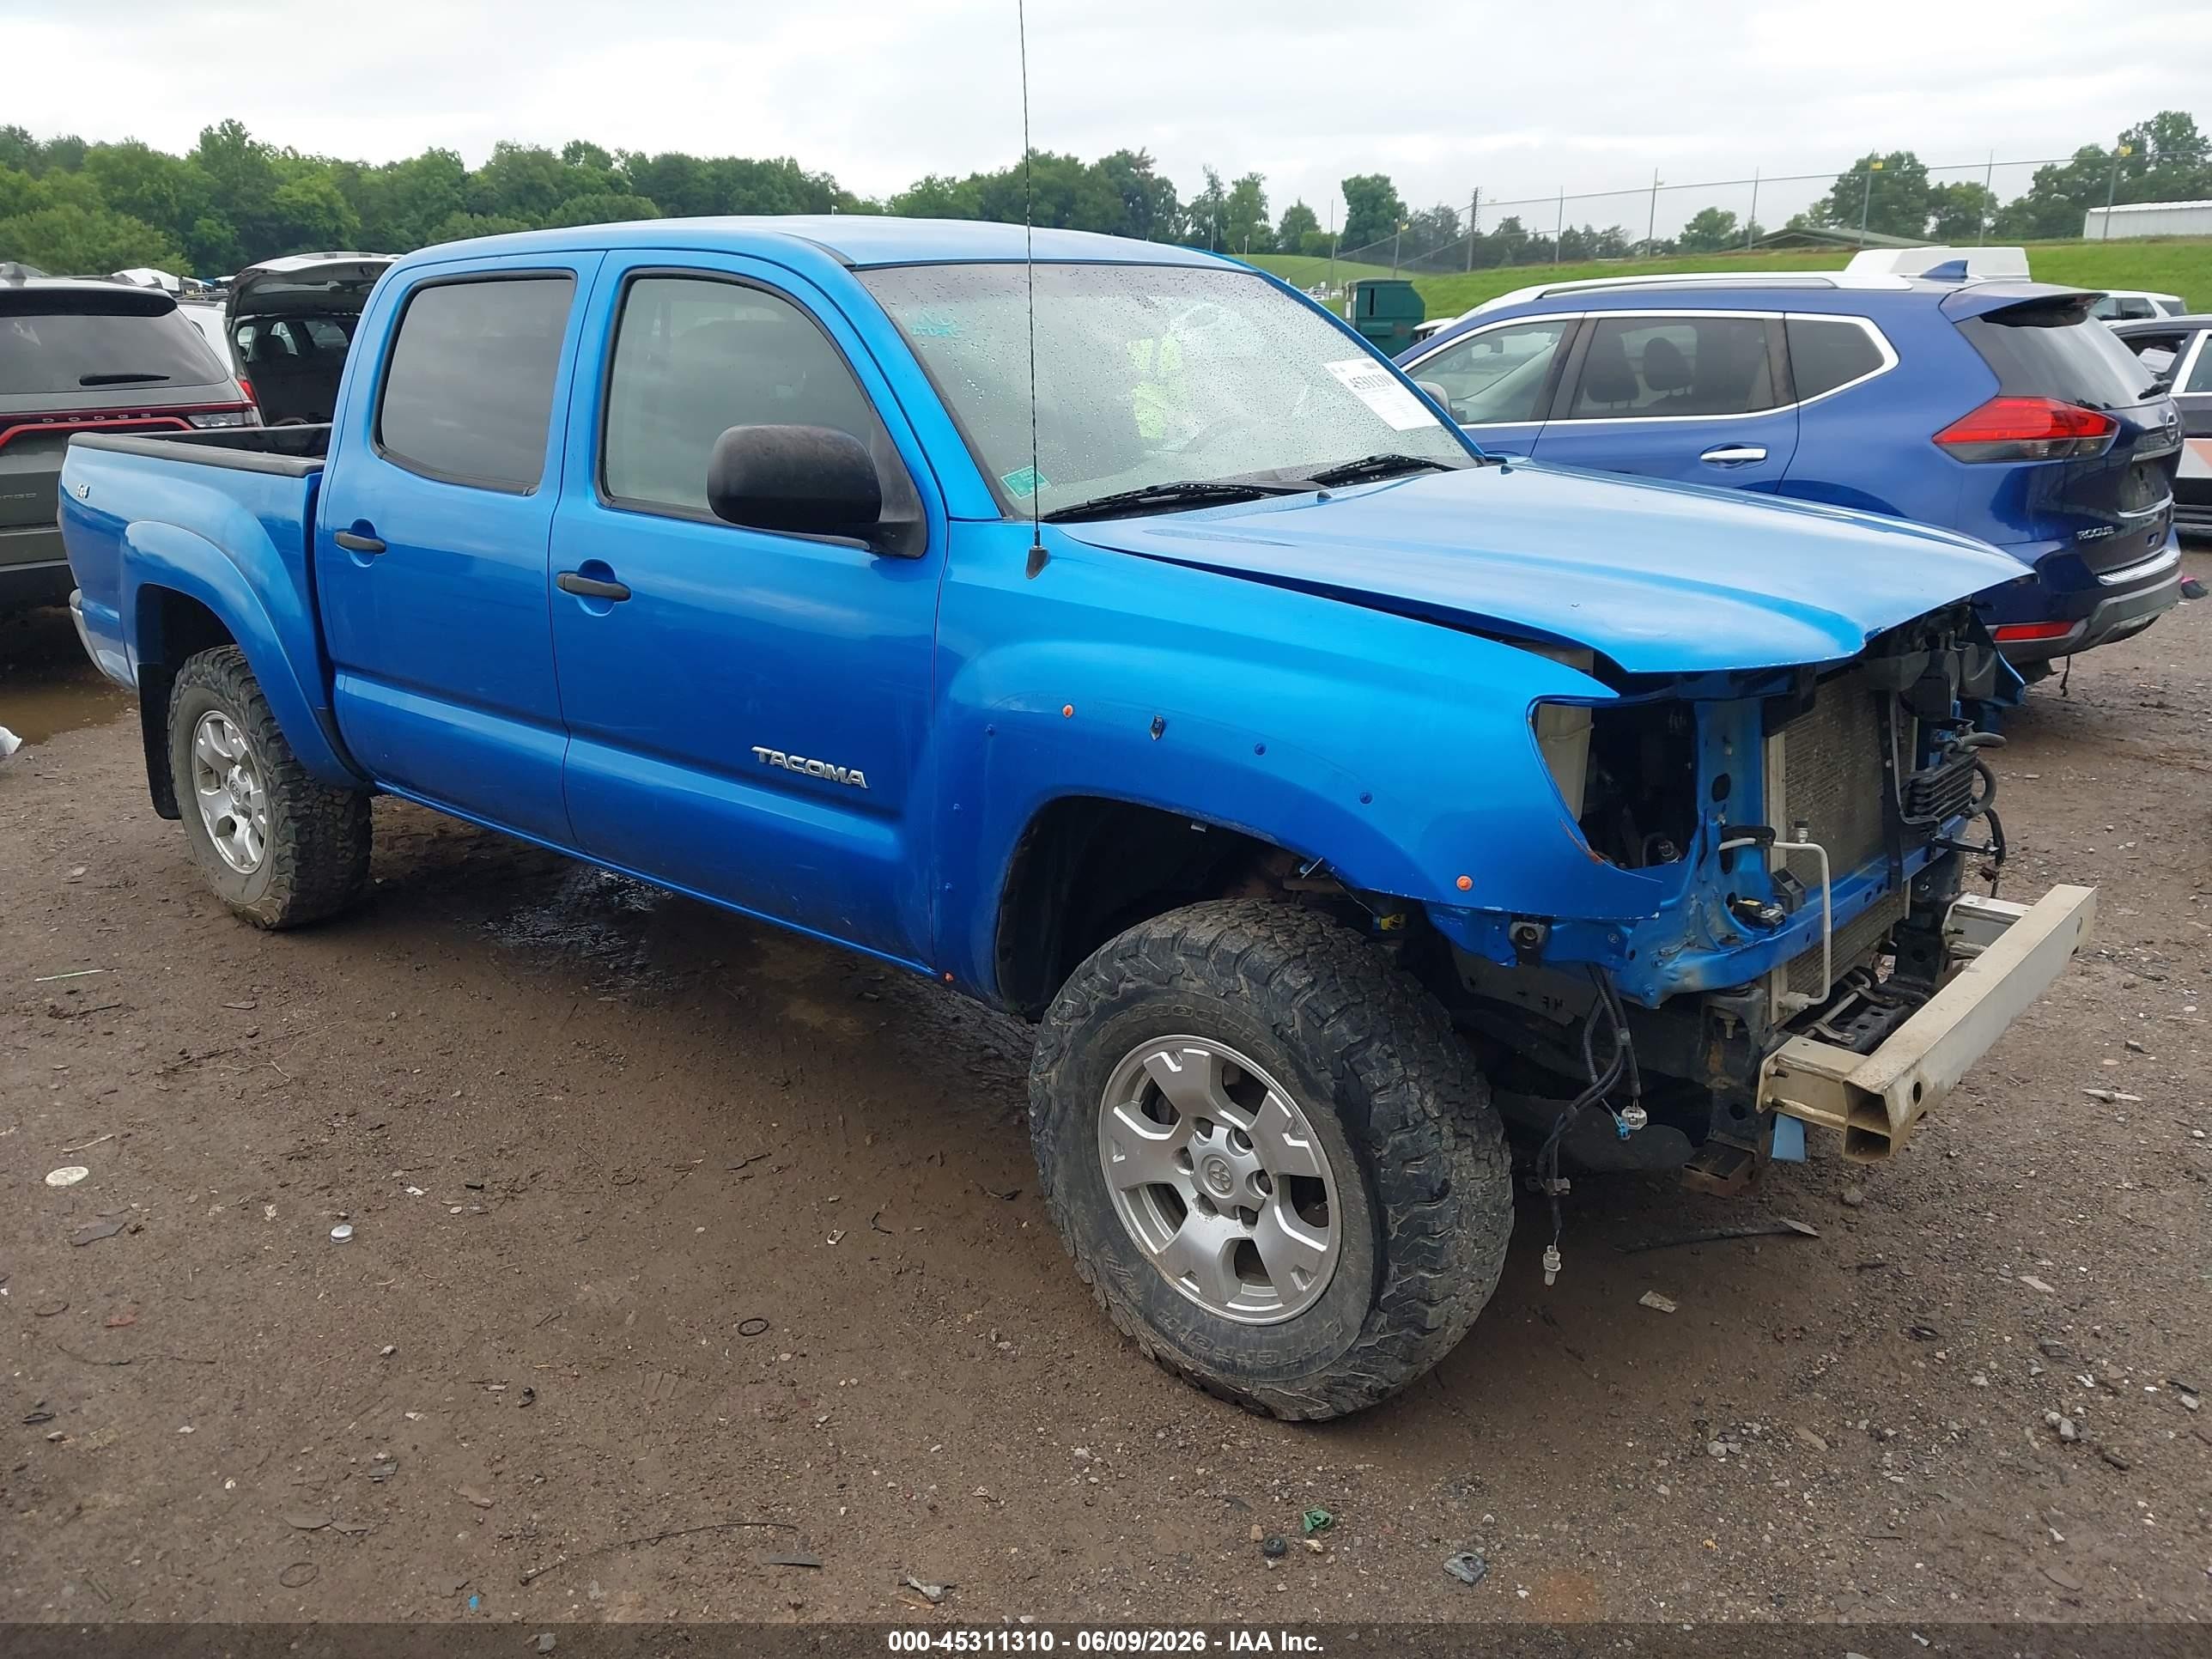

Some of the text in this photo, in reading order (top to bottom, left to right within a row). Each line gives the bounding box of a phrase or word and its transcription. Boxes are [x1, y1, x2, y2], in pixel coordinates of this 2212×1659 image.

[42, 412, 151, 423] DODGE
[2076, 526, 2115, 540] ROGUE
[751, 745, 870, 788] TACOMA
